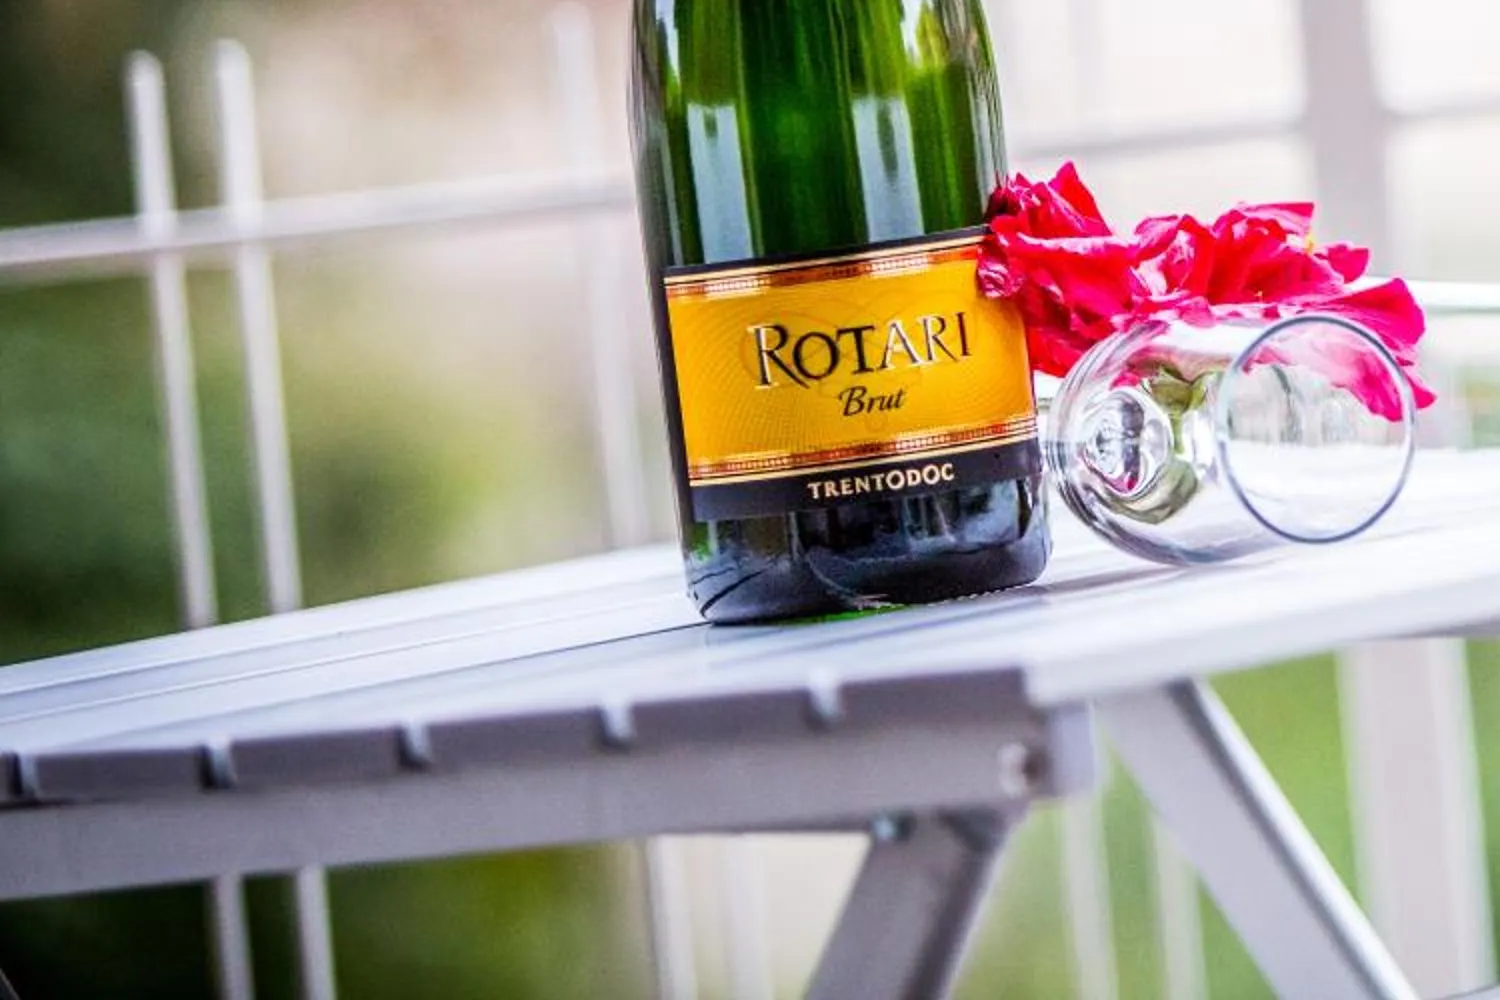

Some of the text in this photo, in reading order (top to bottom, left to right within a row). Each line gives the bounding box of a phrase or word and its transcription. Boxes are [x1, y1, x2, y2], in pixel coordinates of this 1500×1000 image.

[747, 311, 972, 390] ROTARI
[838, 386, 906, 416] Brut
[807, 463, 955, 500] TRENTODOC
